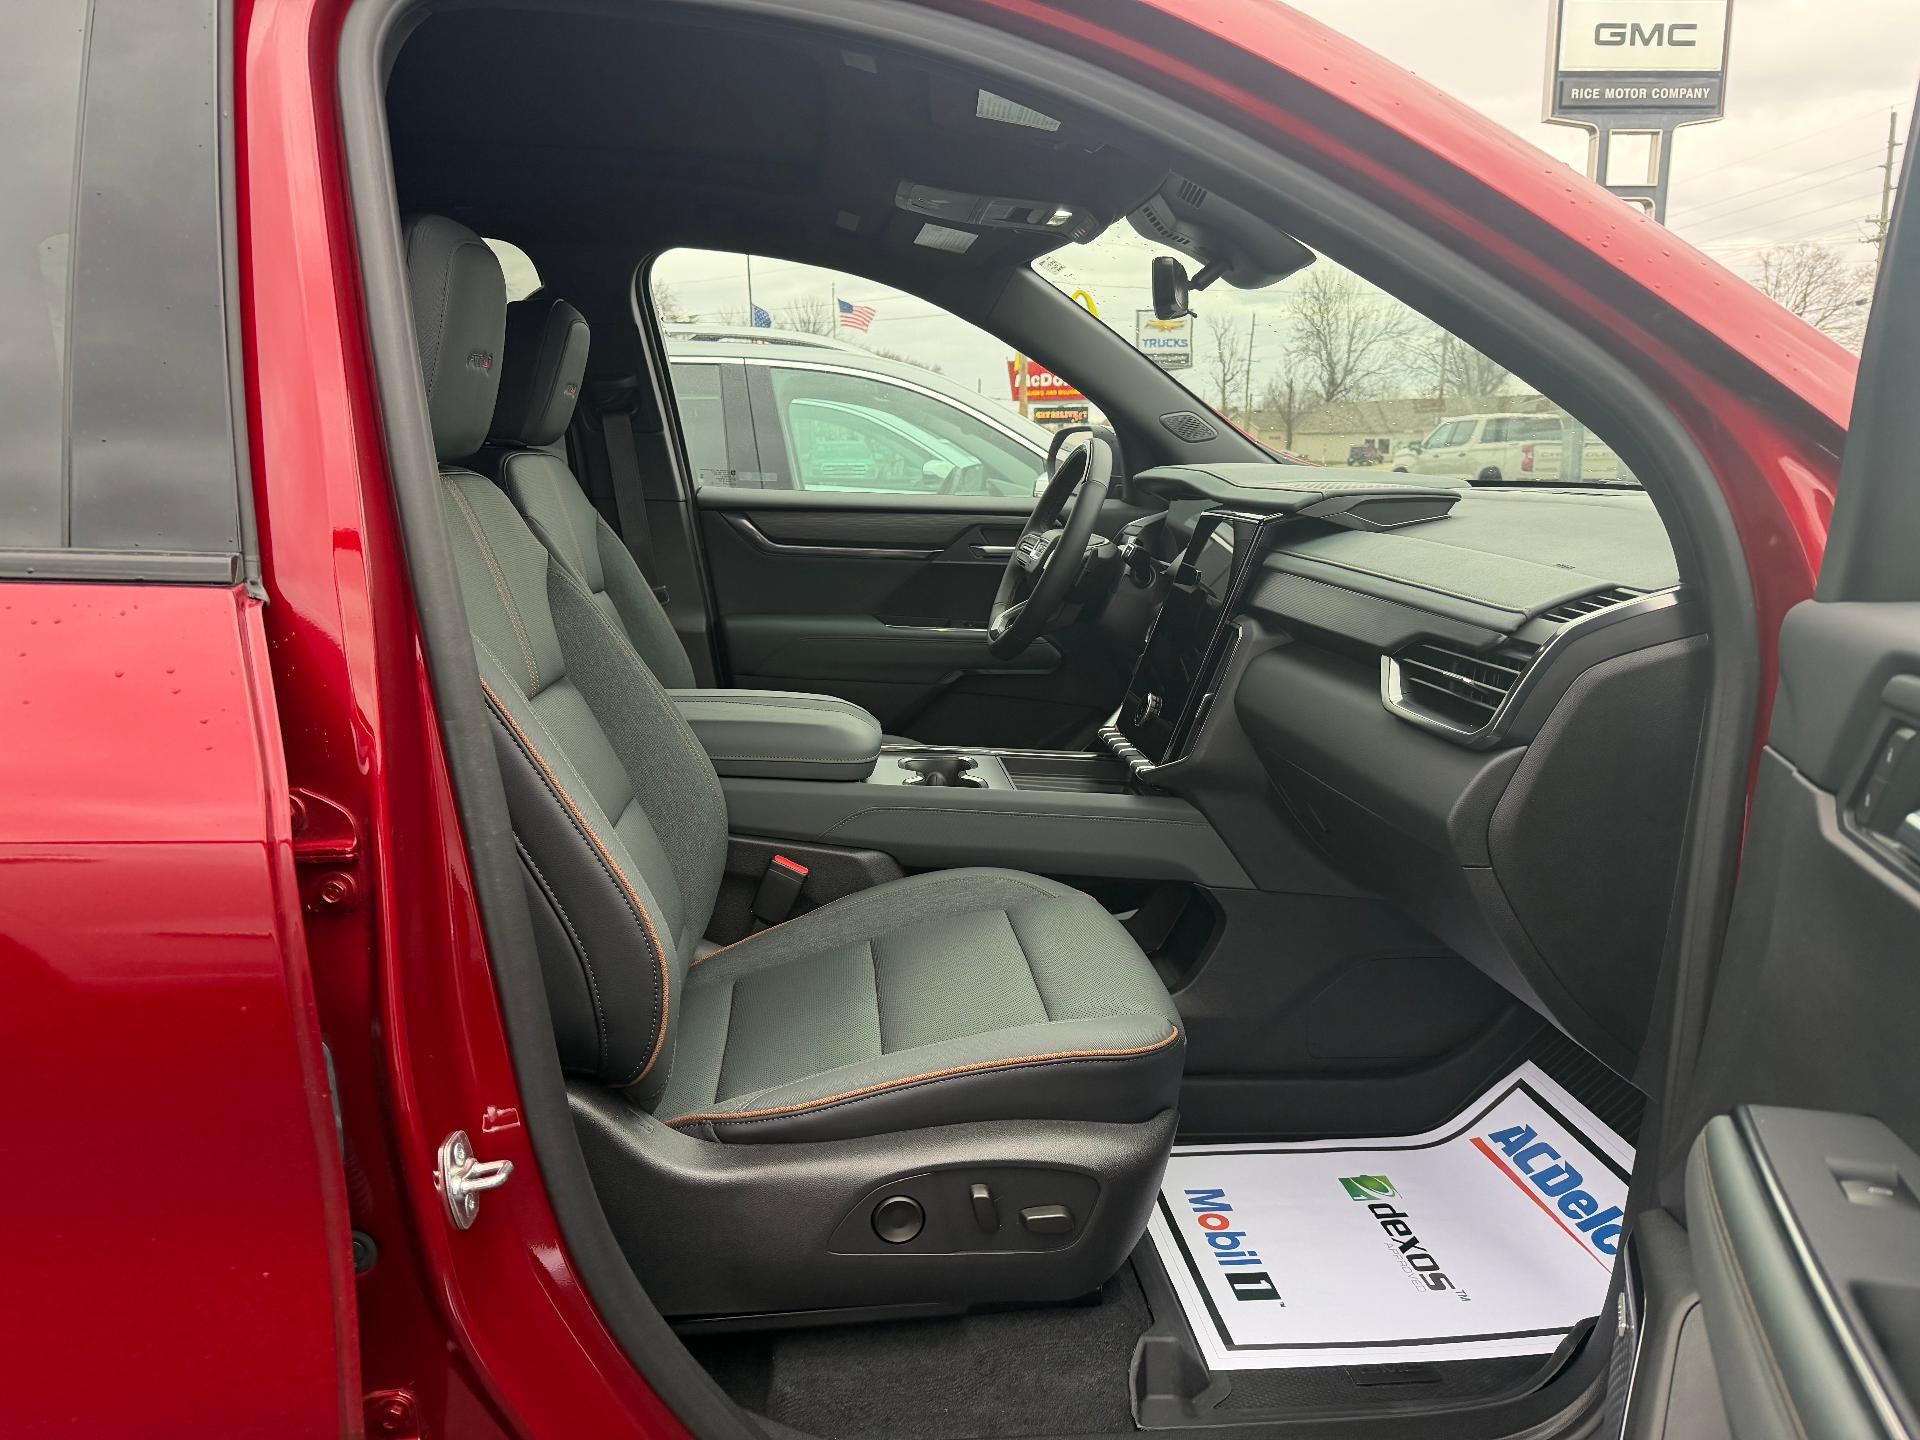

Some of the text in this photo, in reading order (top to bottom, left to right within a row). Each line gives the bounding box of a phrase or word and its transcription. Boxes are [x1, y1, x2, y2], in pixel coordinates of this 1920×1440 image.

[1594, 23, 1698, 46] GMC
[1571, 88, 1711, 99] RICE MOTOR COMPANY
[1142, 338, 1189, 348] TRUCKS
[1014, 372, 1070, 388] McDo
[1488, 1124, 1624, 1256] ACDelc
[1184, 1188, 1263, 1266] Mobil
[1367, 1203, 1456, 1291] dexos
